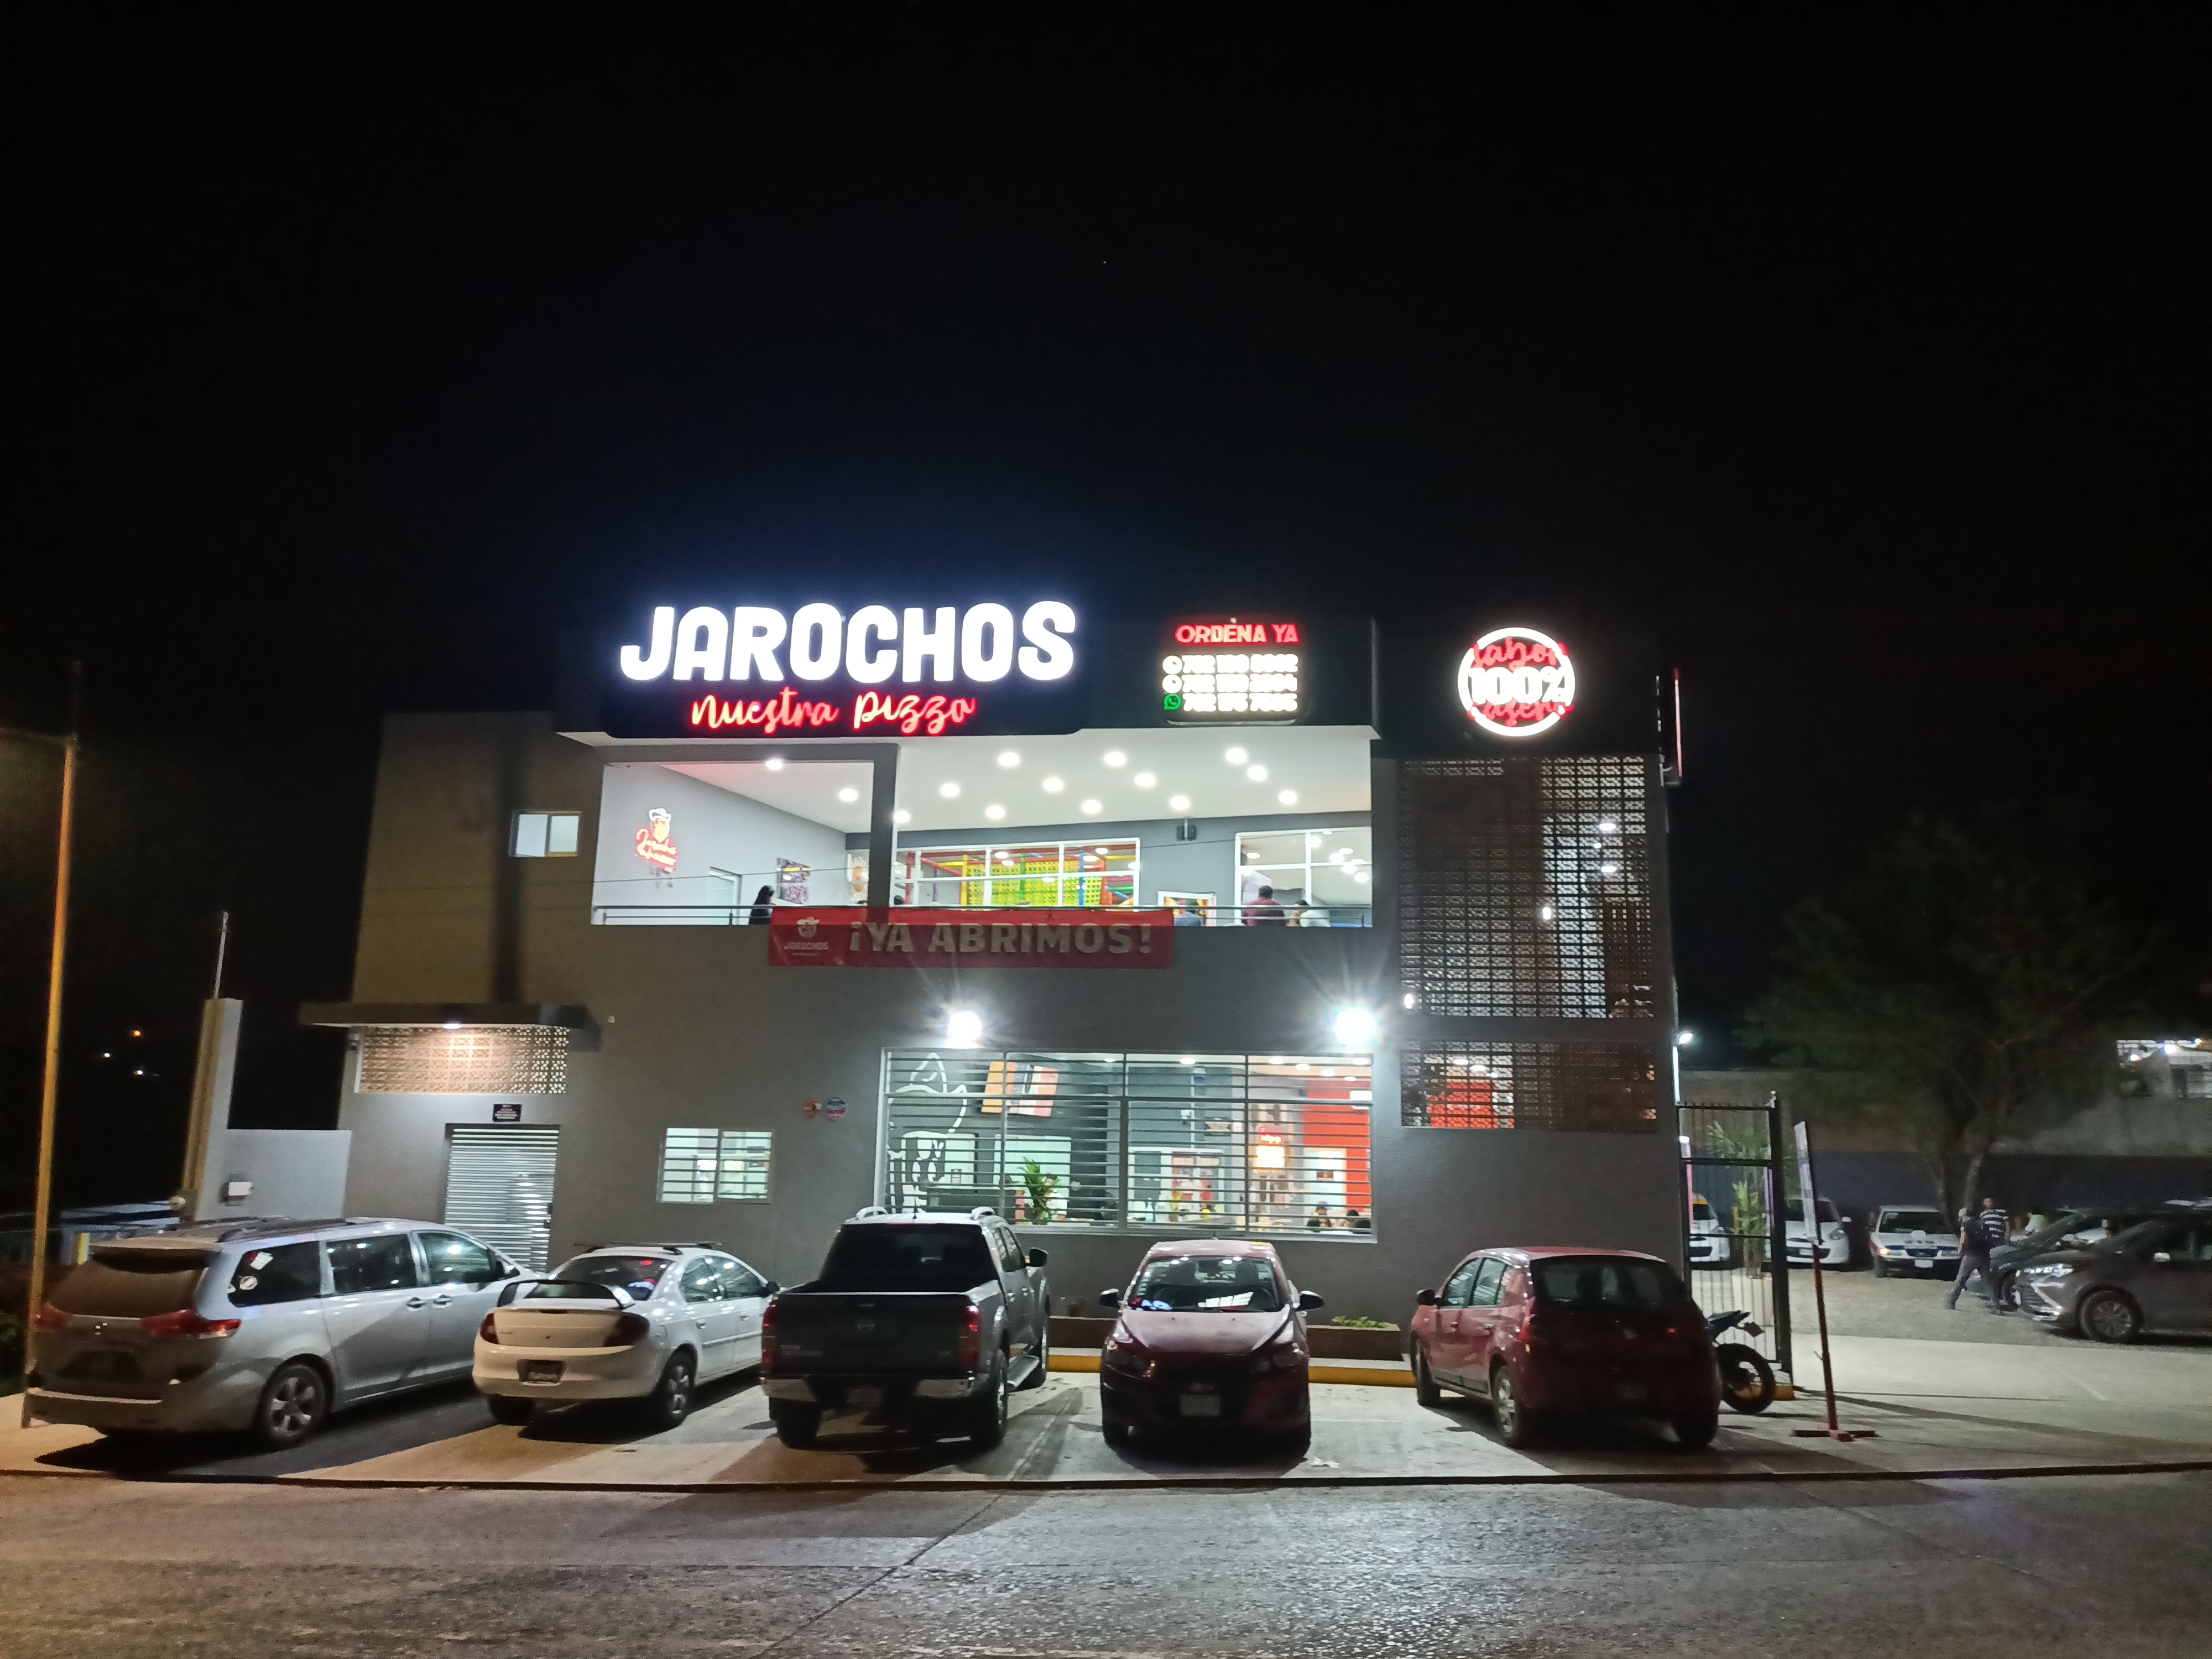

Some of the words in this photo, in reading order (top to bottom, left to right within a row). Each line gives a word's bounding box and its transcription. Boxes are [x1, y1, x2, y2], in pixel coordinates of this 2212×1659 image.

[620, 601, 1076, 682] JAROCHOS
[1176, 624, 1267, 644] ORDENA
[1272, 624, 1300, 644] YA
[1468, 666, 1566, 704] 100%
[849, 921, 915, 952] ¡YA
[928, 923, 1152, 954] ABRIMOS!
